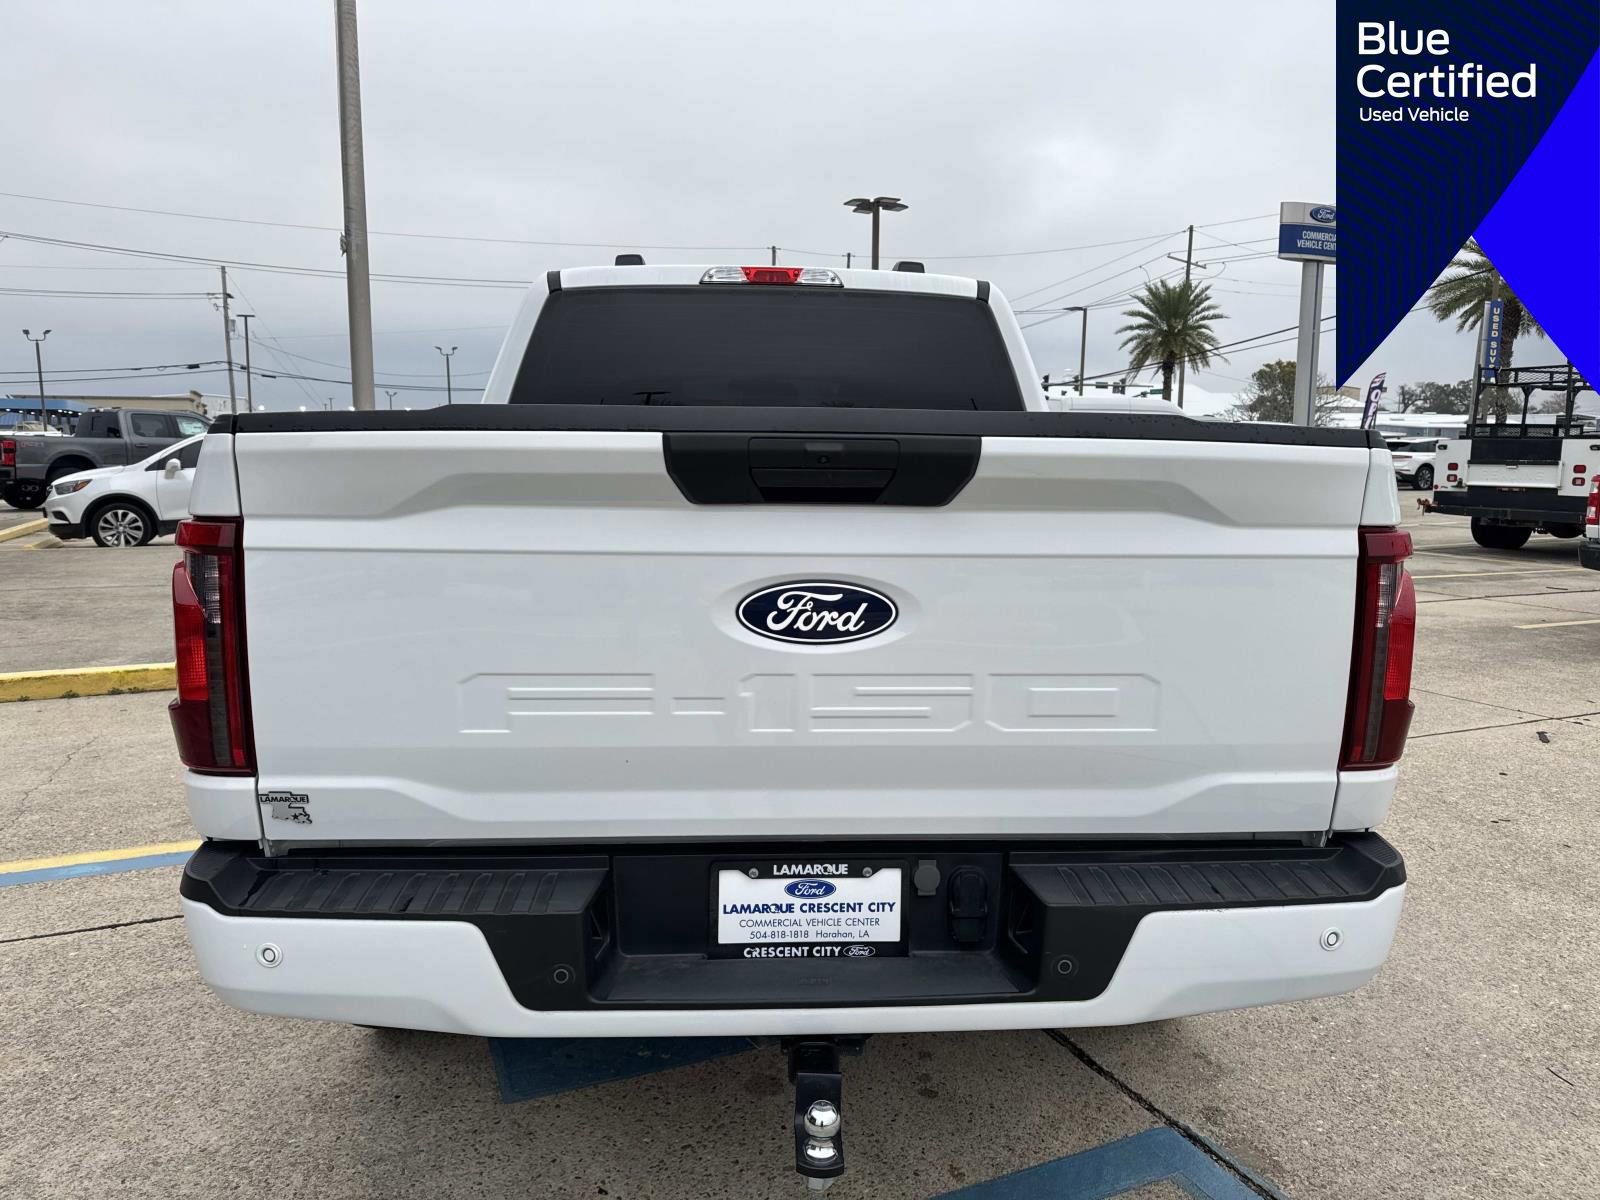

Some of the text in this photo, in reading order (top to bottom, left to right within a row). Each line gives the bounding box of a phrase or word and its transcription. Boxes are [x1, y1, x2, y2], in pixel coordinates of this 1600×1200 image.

[1317, 208, 1335, 219] Ford
[1296, 240, 1322, 249] VEHICLE
[1491, 307, 1500, 337] USED
[765, 589, 868, 634] Ford
[457, 673, 1161, 733] F-150
[773, 864, 848, 876] LAMARQUE
[795, 882, 825, 896] Ford
[723, 902, 896, 914] LAMARQUE CRESCENT CITY
[739, 918, 880, 928] COMMERCIAL VEHICLE CENTER
[750, 930, 870, 939] 504-818-1818 Harahan, LA
[744, 946, 809, 958] CRESCENT
[813, 946, 842, 957] CITY
